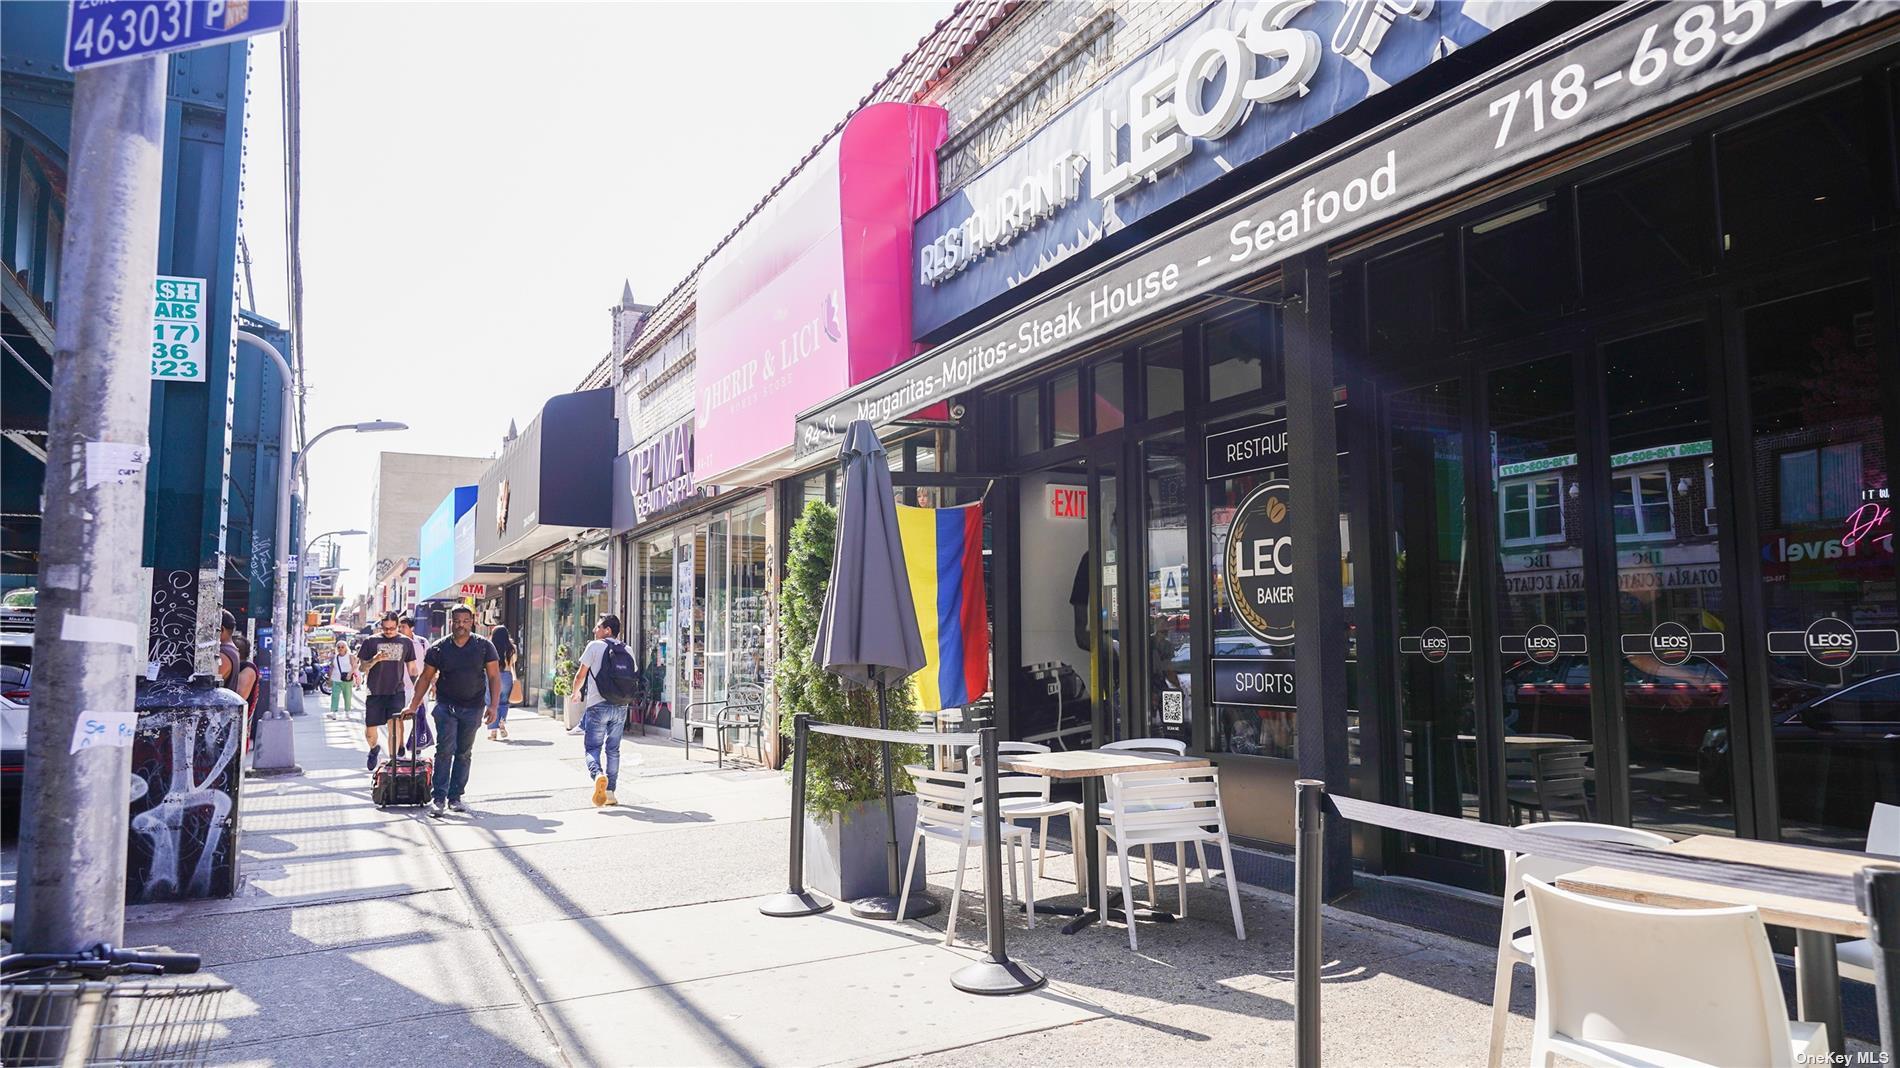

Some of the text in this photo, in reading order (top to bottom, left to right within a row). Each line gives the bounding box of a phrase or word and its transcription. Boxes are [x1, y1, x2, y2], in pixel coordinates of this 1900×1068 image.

[74, 0, 192, 58] 463031
[920, 151, 1078, 288] RESTAURANT
[1091, 262, 1179, 322] House
[1229, 150, 1397, 265] Seafood
[157, 282, 197, 300] $H
[155, 302, 197, 319] ARS
[763, 349, 776, 381] &
[638, 483, 667, 517] BEAUTY
[1055, 489, 1087, 518] EXIT
[461, 584, 484, 595] ATM
[1164, 571, 1178, 598] A
[1257, 586, 1294, 605] BAKER
[1654, 636, 1688, 648] LEO'S
[1809, 633, 1853, 647] LEO'S
[1235, 672, 1294, 694] SPORTS
